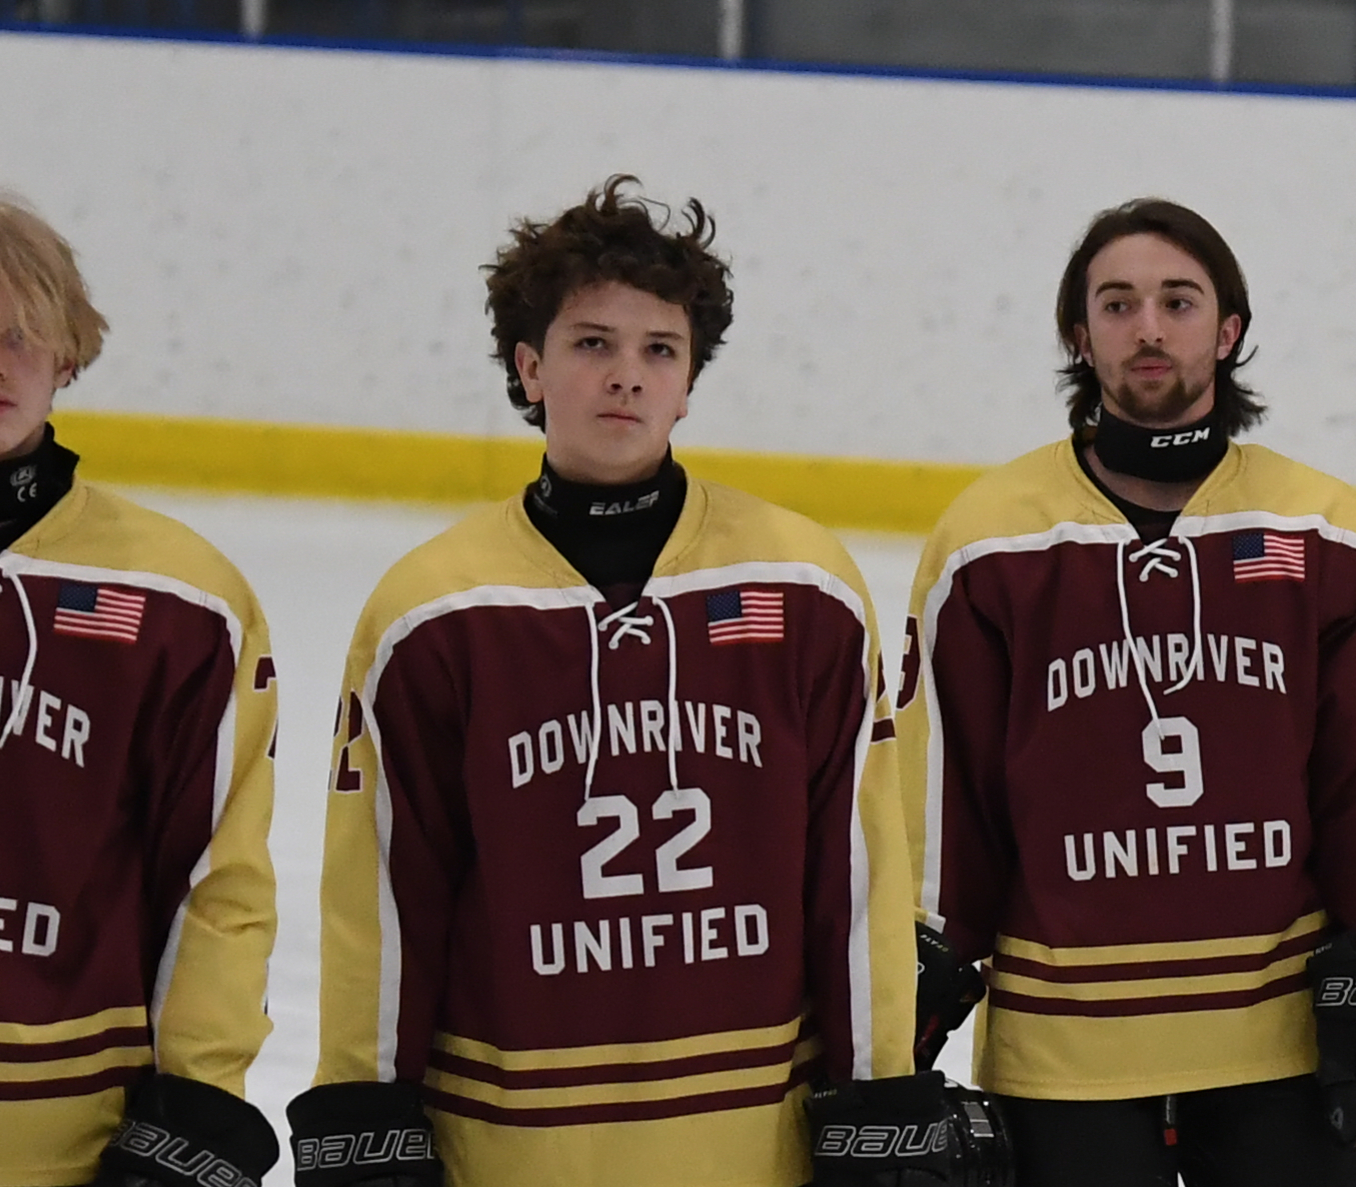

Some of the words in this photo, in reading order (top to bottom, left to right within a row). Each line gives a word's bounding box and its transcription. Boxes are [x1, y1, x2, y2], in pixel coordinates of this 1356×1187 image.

[1150, 427, 1210, 449] CCM
[1047, 632, 1287, 712] DOWNRIVER
[507, 699, 763, 789] DOWNRIVER
[1141, 716, 1204, 808] 9
[576, 787, 715, 900] 22
[1064, 820, 1293, 881] UNIFIED
[530, 904, 769, 976] UNIFIED
